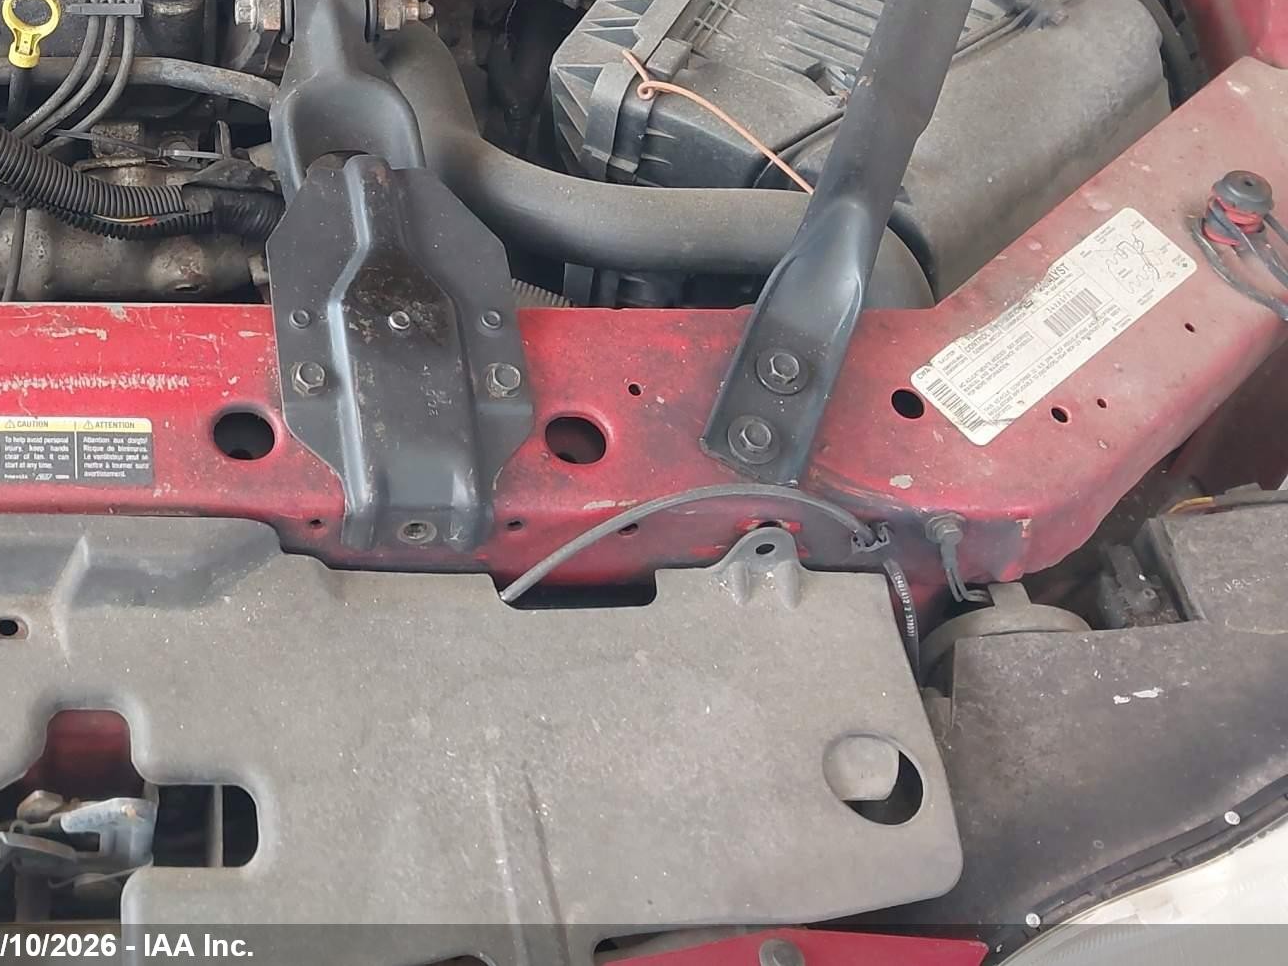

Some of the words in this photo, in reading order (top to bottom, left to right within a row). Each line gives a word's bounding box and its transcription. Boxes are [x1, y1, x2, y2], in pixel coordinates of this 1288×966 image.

[17, 420, 48, 428] CAUTION
[95, 421, 135, 429] ATTENTION
[13, 436, 25, 444] help
[44, 436, 69, 444] personal
